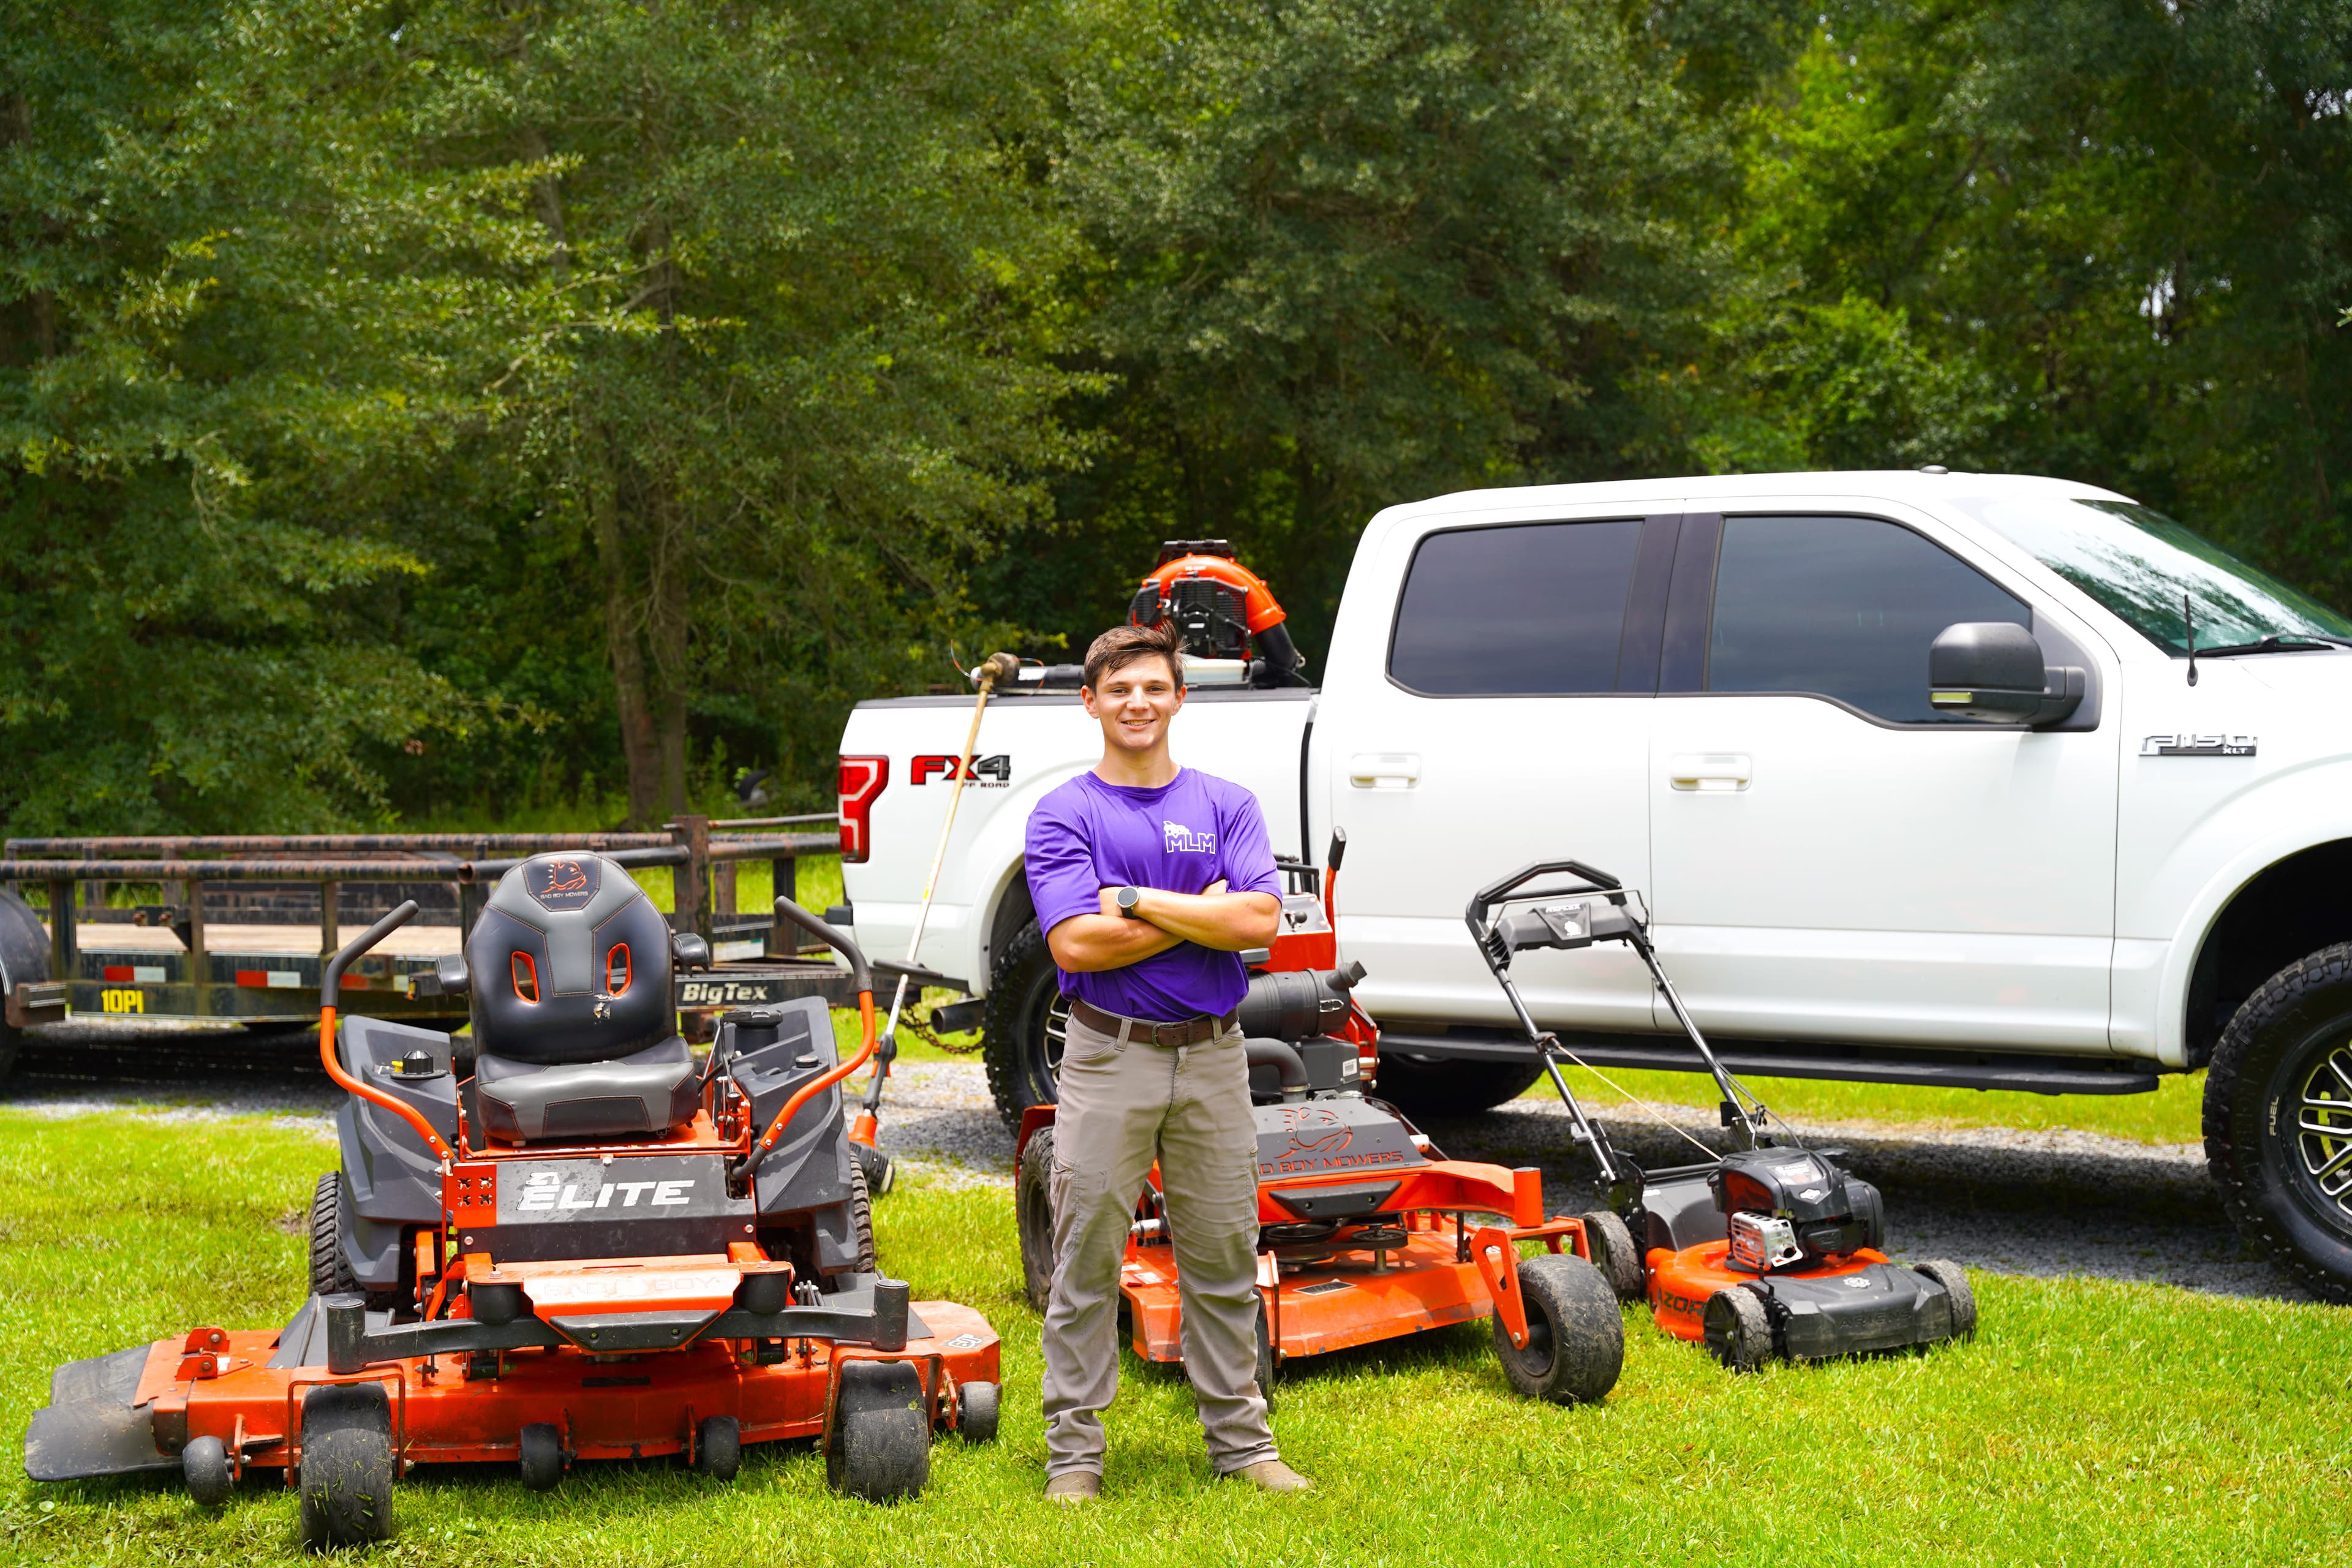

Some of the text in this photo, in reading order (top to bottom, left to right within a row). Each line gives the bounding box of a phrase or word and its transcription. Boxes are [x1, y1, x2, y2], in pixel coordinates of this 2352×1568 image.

[911, 755, 1011, 785] FX4
[1165, 832, 1216, 854] MLM
[682, 982, 769, 1005] BigTex
[2269, 1095, 2279, 1136] FUEL
[1280, 1158, 1317, 1174] BOY
[1323, 1151, 1404, 1169] MOWERS
[517, 1180, 695, 1211] ELITE
[1839, 1310, 1912, 1329] ARIENS
